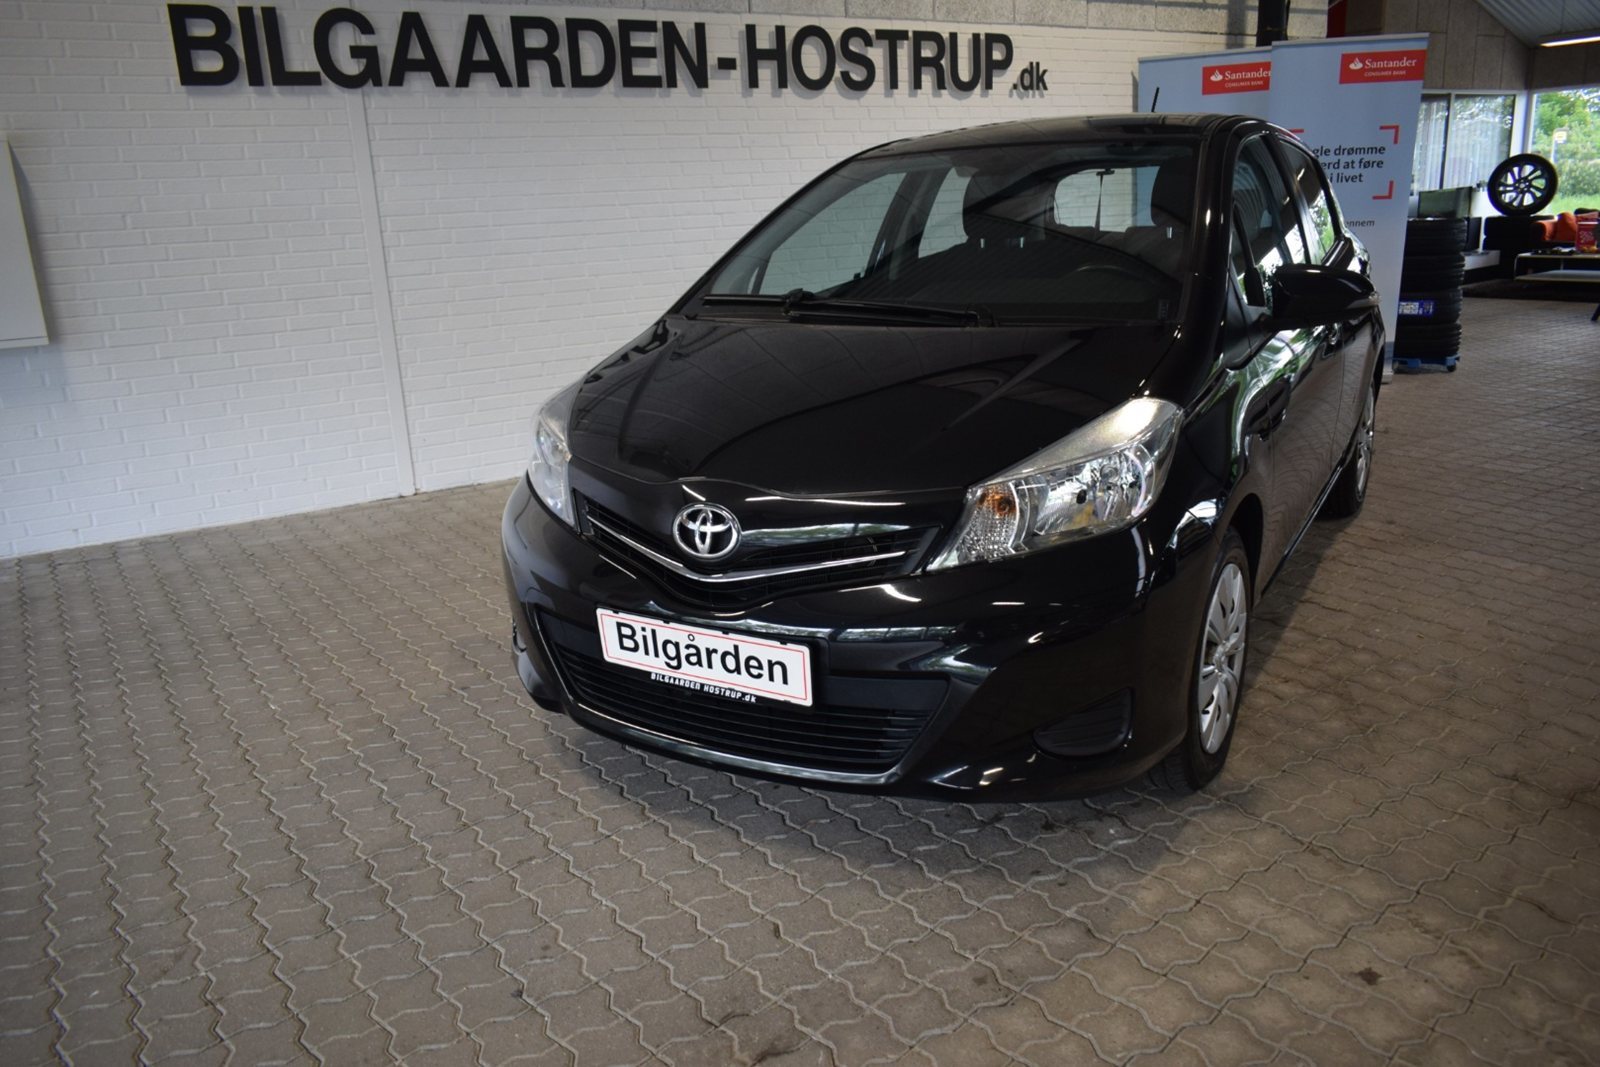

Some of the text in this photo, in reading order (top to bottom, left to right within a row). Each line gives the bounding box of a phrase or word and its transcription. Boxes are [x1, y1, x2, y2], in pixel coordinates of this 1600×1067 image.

[167, 3, 1048, 92] BILGAARDEN-HOSTRUP.dk
[1364, 57, 1417, 69] Santander
[1311, 145, 1386, 158] gle drømme
[1321, 158, 1384, 170] erd at føre
[1336, 172, 1363, 183] livet
[616, 621, 789, 686] Bilgården
[650, 672, 757, 703] BILGAARDEN HOSTRUP.dk
